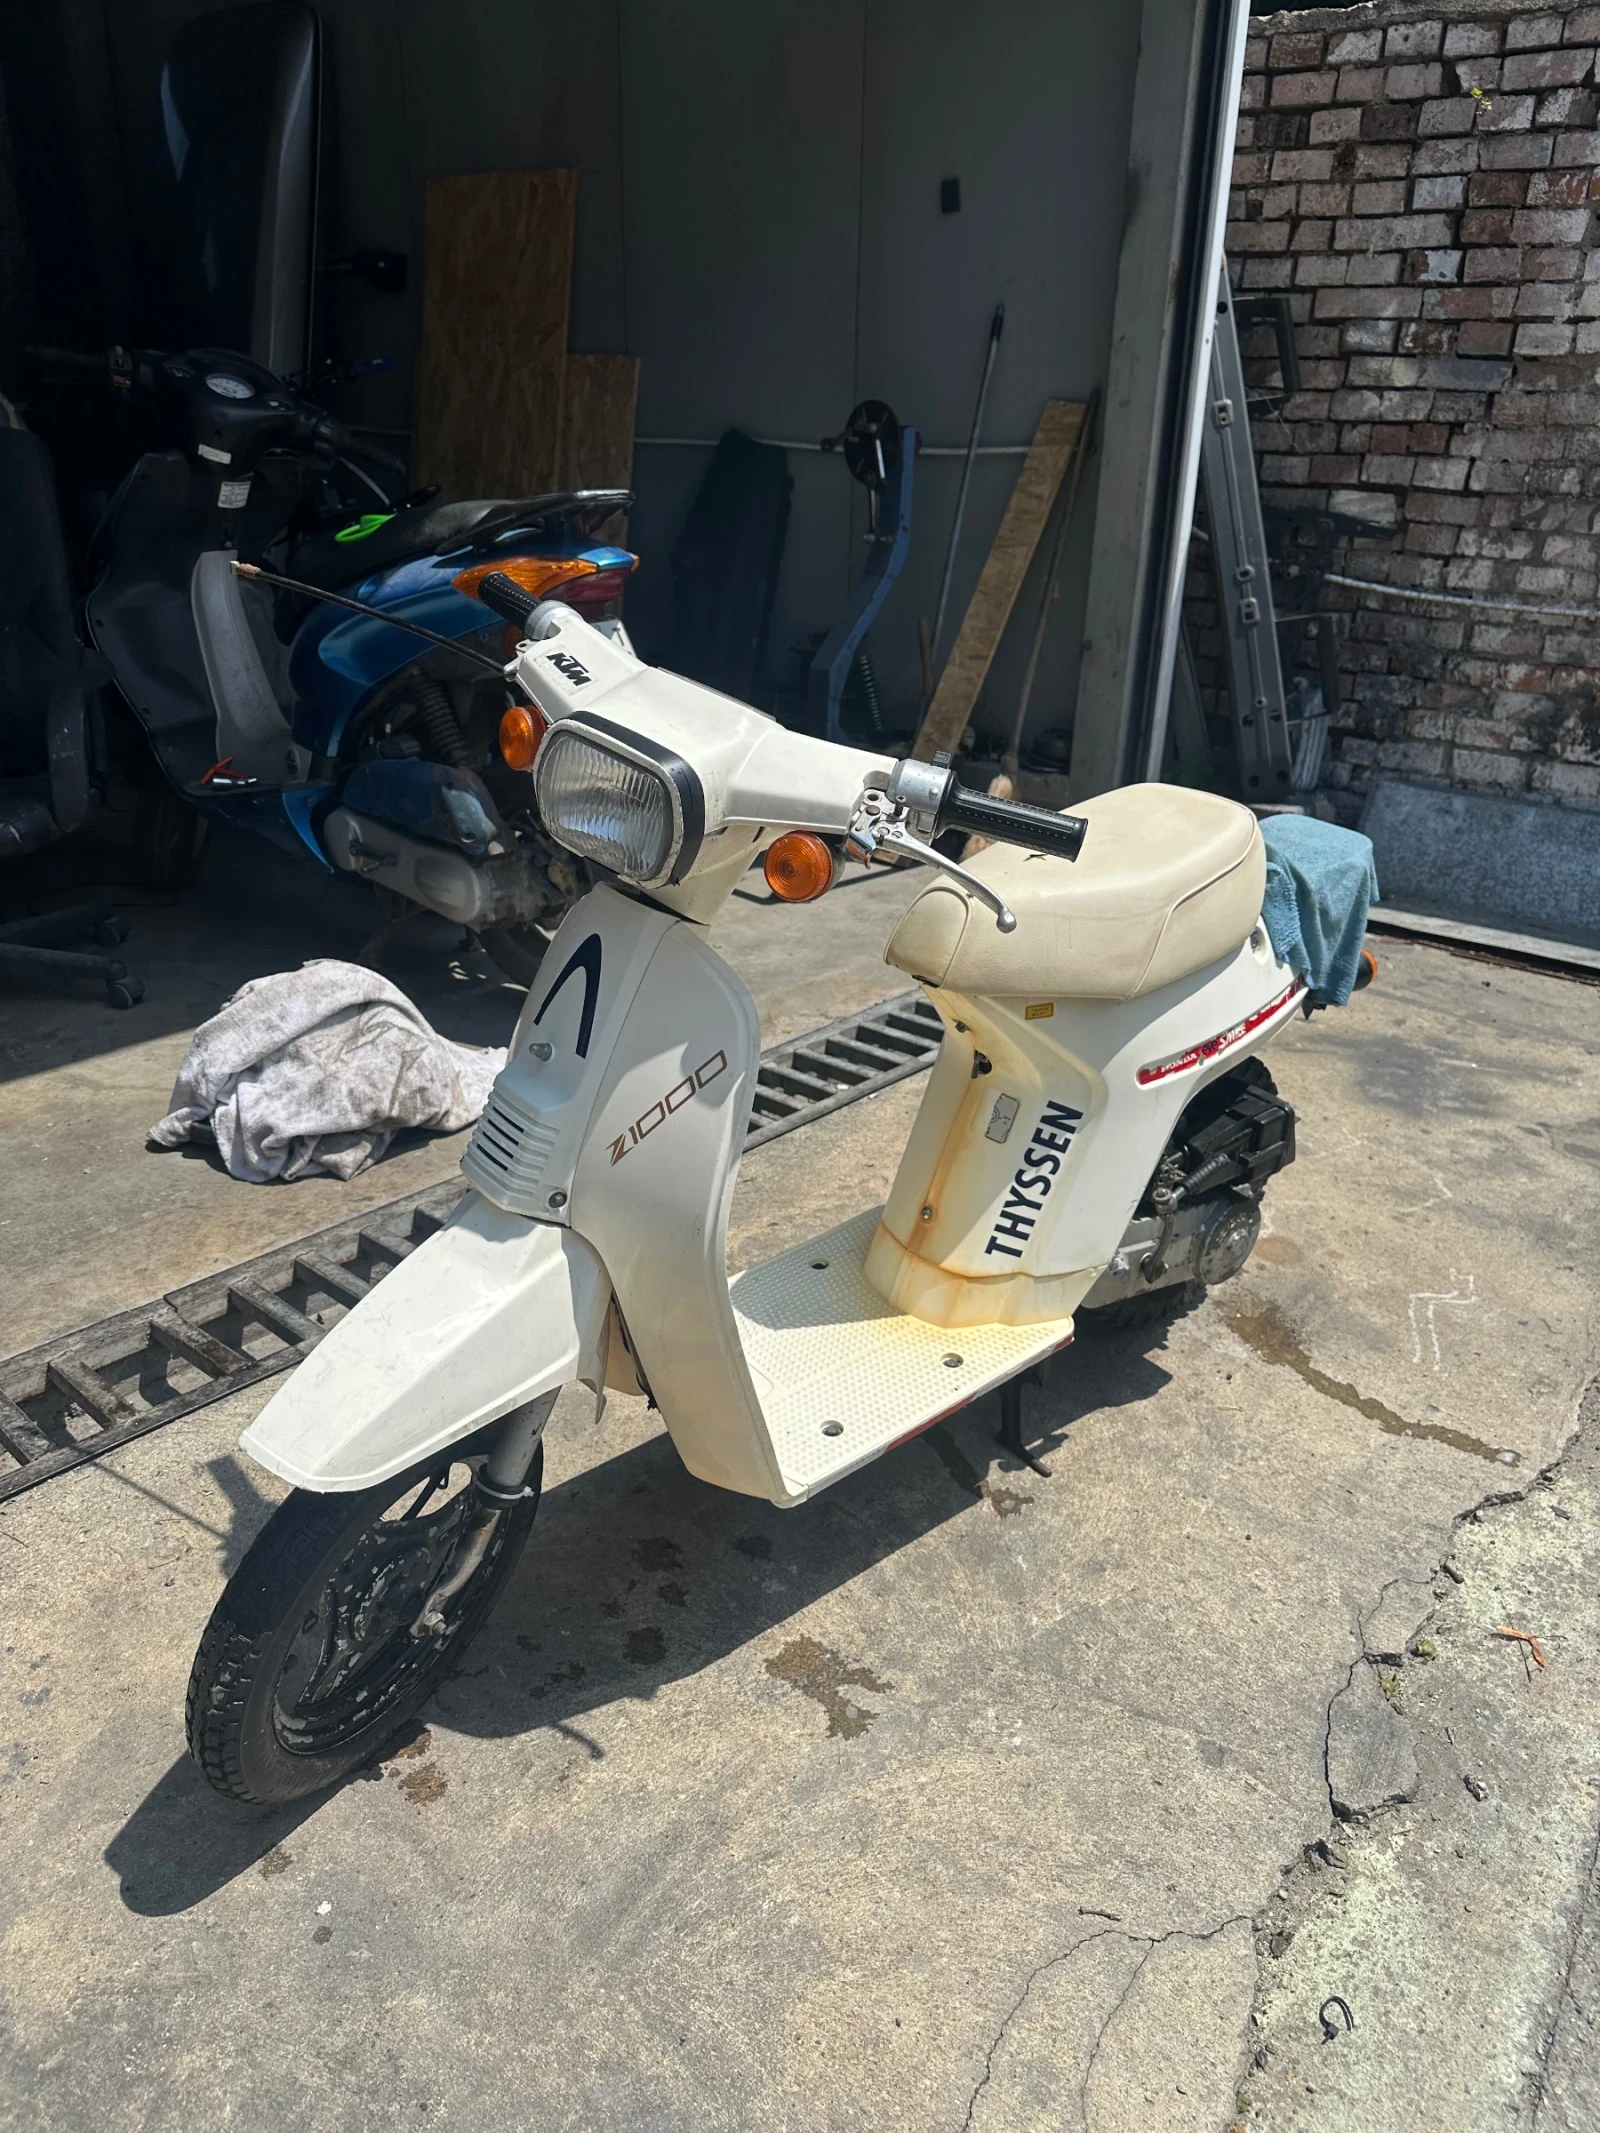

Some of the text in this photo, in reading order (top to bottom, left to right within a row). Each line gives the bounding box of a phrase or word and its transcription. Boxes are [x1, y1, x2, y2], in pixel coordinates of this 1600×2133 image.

[546, 653, 592, 686] KTM
[1160, 1052, 1198, 1072] HONDA
[605, 1049, 728, 1166] Z1000
[985, 1100, 1084, 1258] THYSSEN
